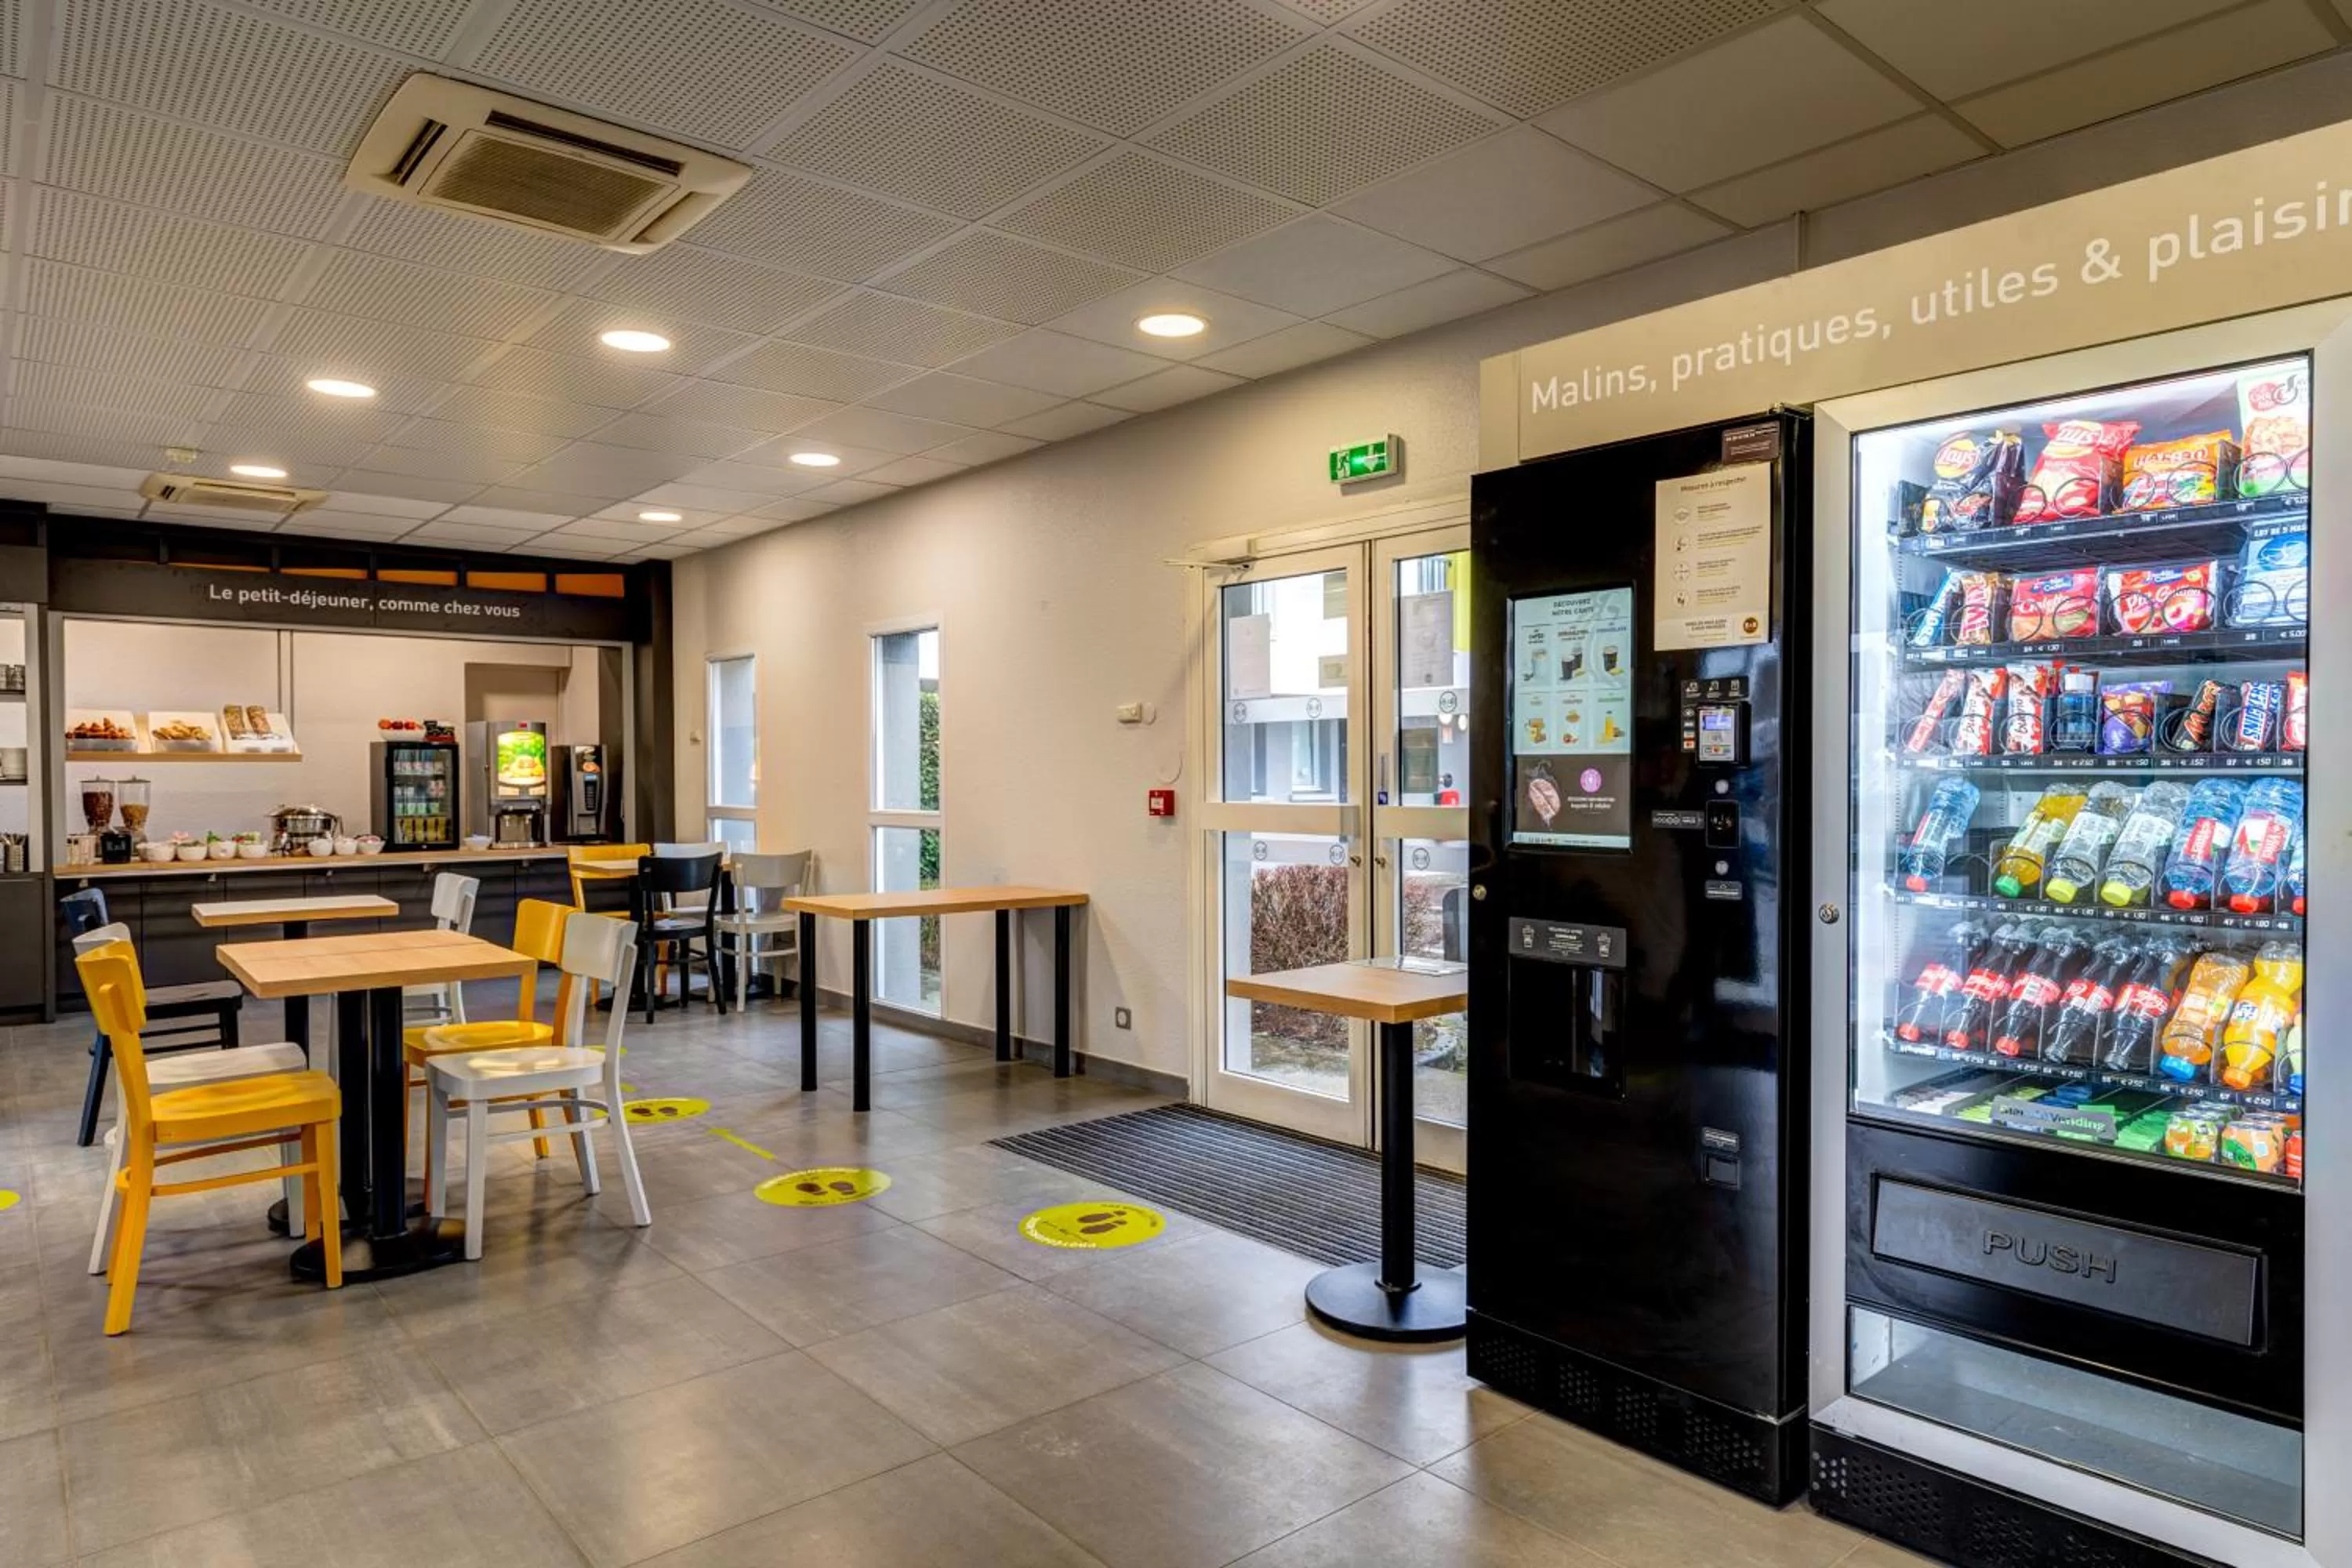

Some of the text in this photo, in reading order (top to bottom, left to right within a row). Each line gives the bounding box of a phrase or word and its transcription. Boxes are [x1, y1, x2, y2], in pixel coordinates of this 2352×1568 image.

[1531, 365, 1657, 414] Malins,
[1671, 307, 1893, 391] pratiques,
[1910, 263, 2059, 325] utiles
[2081, 238, 2124, 285] &
[209, 583, 521, 618] Le petit-déjeuner, comme chez vous
[1982, 1229, 2117, 1284] PUSH
